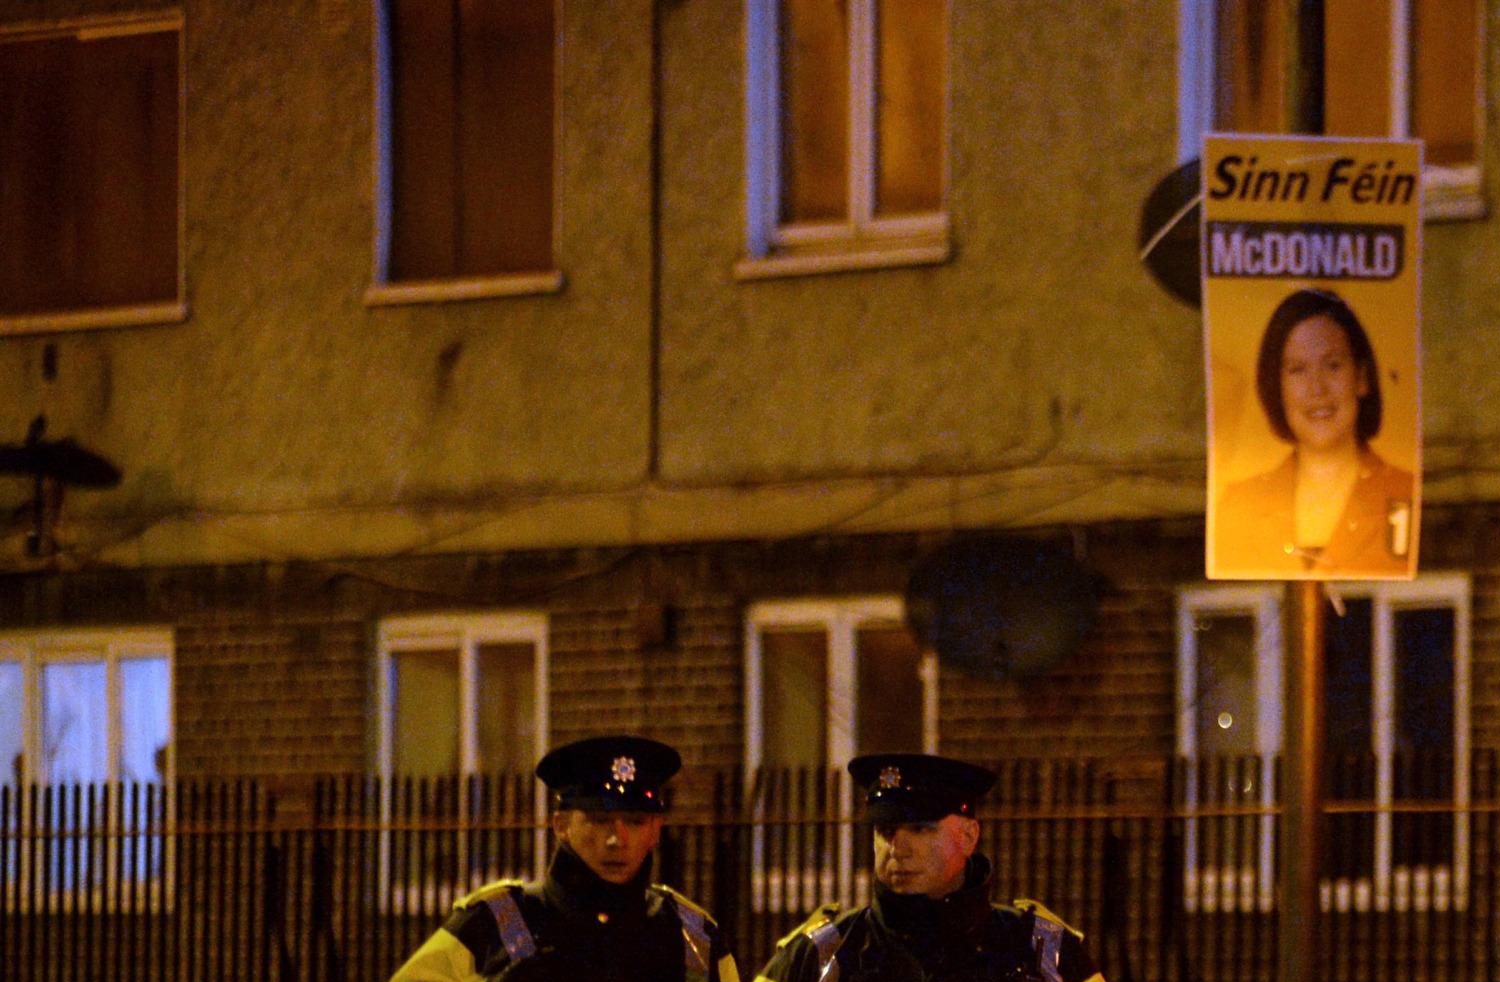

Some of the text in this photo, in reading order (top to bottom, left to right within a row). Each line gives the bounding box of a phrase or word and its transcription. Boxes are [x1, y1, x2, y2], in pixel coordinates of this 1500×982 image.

[1210, 154, 1416, 204] Sinn Féin
[1211, 231, 1398, 277] McDONALD
[1388, 502, 1410, 556] 1
